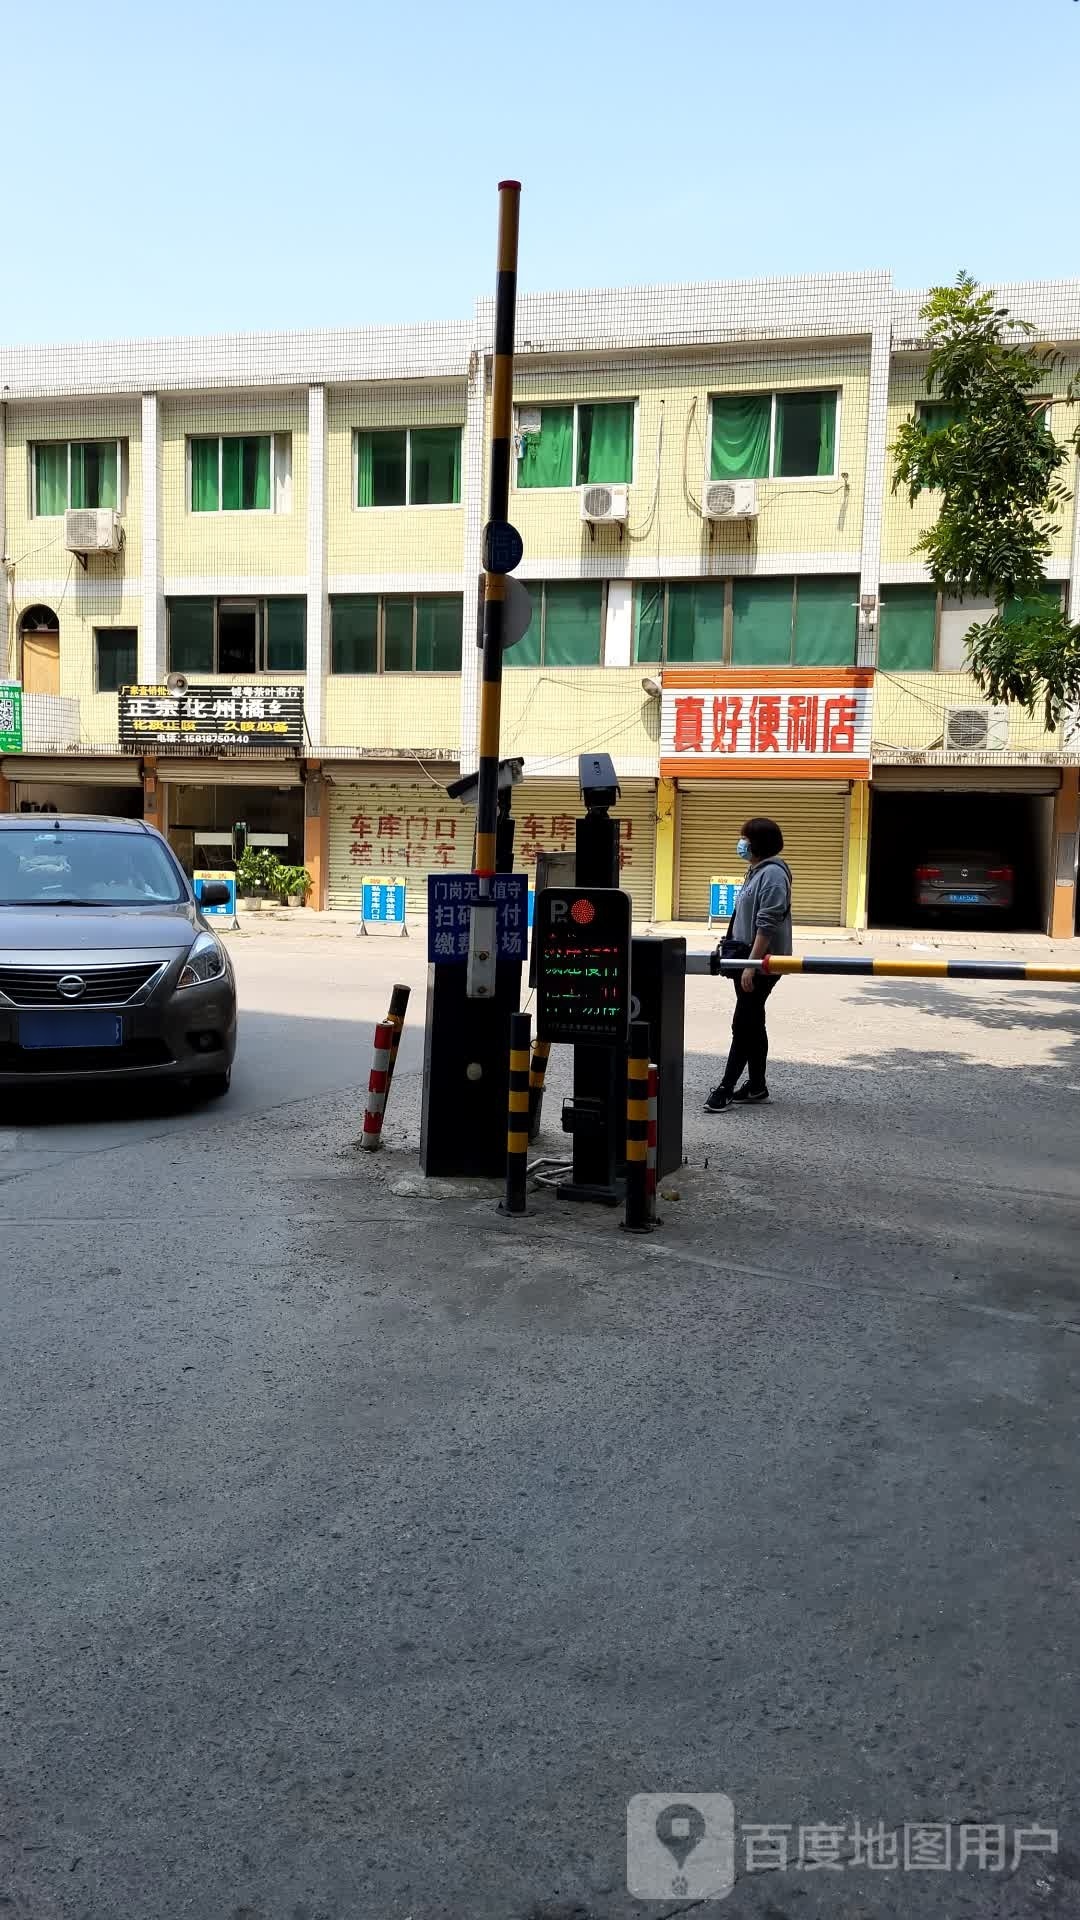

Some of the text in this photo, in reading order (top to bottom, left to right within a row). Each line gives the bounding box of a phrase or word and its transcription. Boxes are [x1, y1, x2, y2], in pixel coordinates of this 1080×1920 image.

[121, 686, 173, 696] 厂家直销批
[673, 695, 857, 753] 真好便利店
[350, 814, 456, 839] 车库门口
[350, 841, 456, 868] 禁止停车
[434, 881, 521, 900] 门岗无值守
[434, 903, 522, 928] 扫码付
[434, 931, 522, 955] 缴费场
